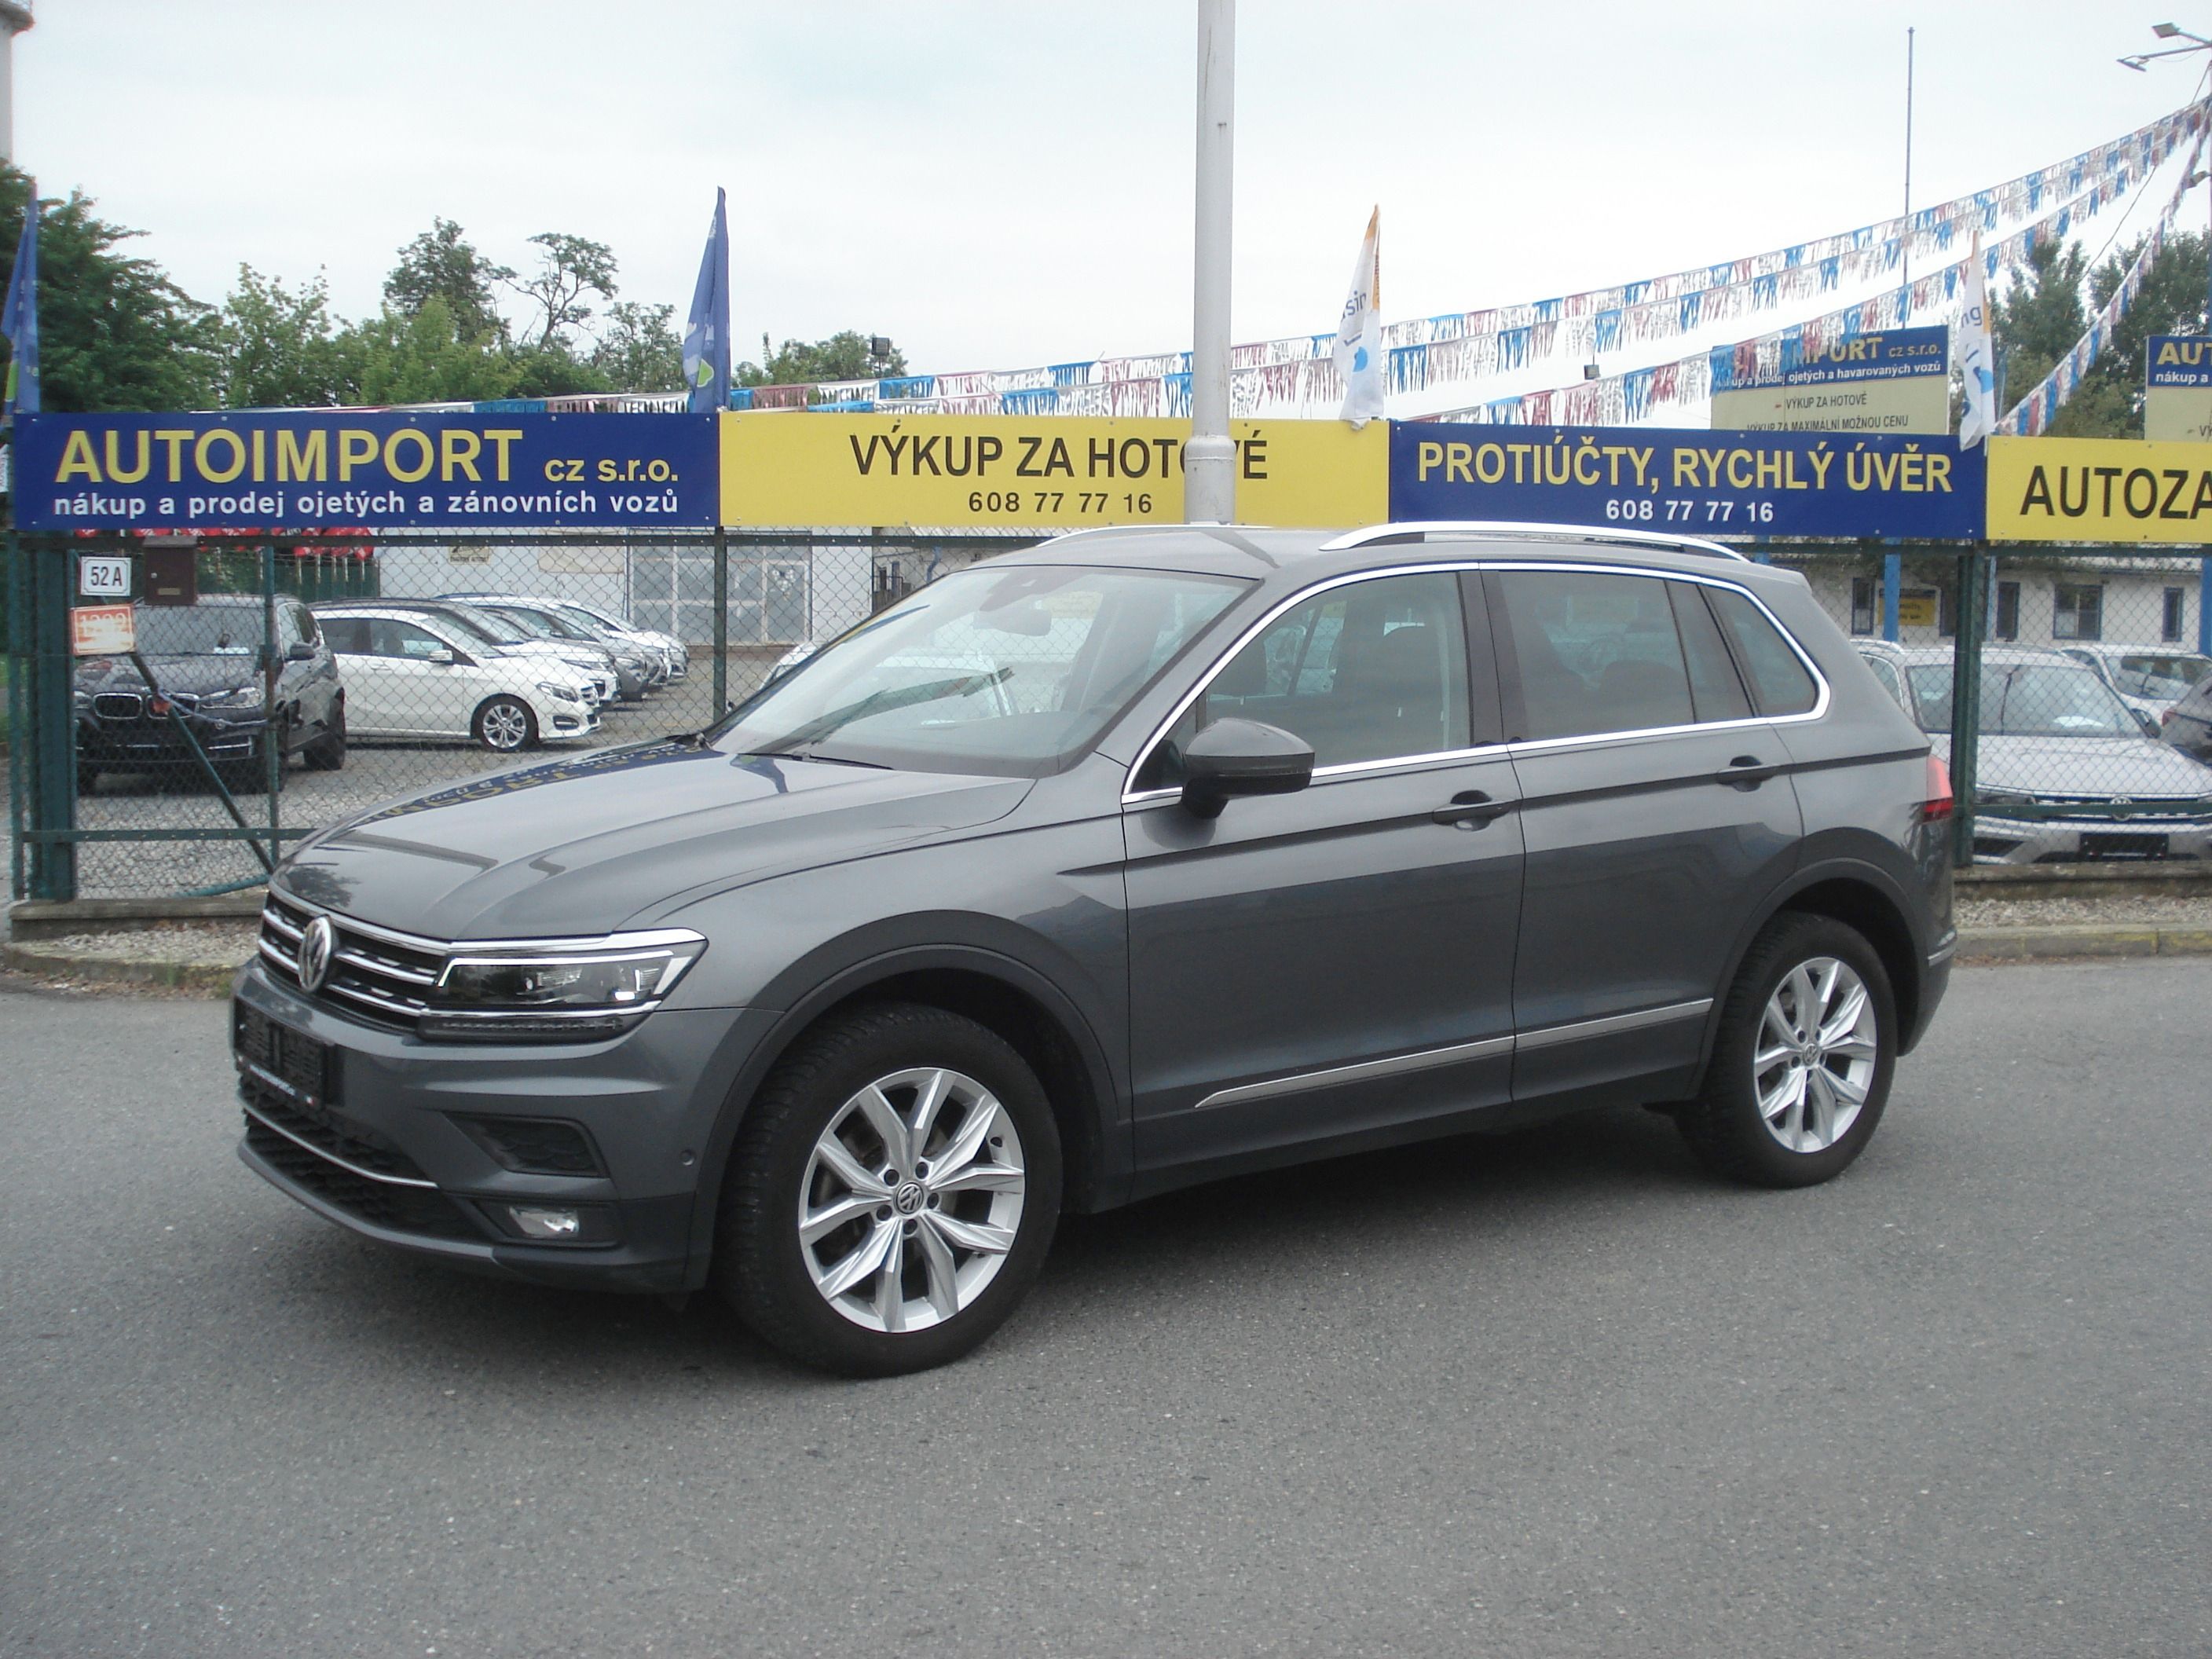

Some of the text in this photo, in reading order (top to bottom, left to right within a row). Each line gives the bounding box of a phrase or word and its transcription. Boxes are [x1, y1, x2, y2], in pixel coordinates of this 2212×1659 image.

[1888, 343, 1942, 358] cz s.r.o.
[1788, 369, 1825, 384] ojetých
[1837, 363, 1911, 379] havarovaných
[2155, 371, 2209, 386] nákup a
[1785, 391, 1867, 409] VÝKUP ZA HOTOVÉ
[1791, 416, 1840, 431] MAXIMÁLNÍ
[1841, 415, 1881, 430] MOŽNOU
[1883, 414, 1909, 427] CENU
[54, 428, 679, 483] AUTOIMPORT cz s.r.o.
[849, 424, 1268, 479] VÝKUP ZA HOTÉ
[1418, 435, 1953, 494] PROTIÚČTY, RYCHLÝ ÚVĚR
[54, 488, 677, 519] nákup a prodej ojetých a zánovních vozů
[968, 492, 1152, 514] 608 77 77 16
[1606, 499, 1774, 522] 608 77 77 16
[90, 566, 123, 587] 52 A
